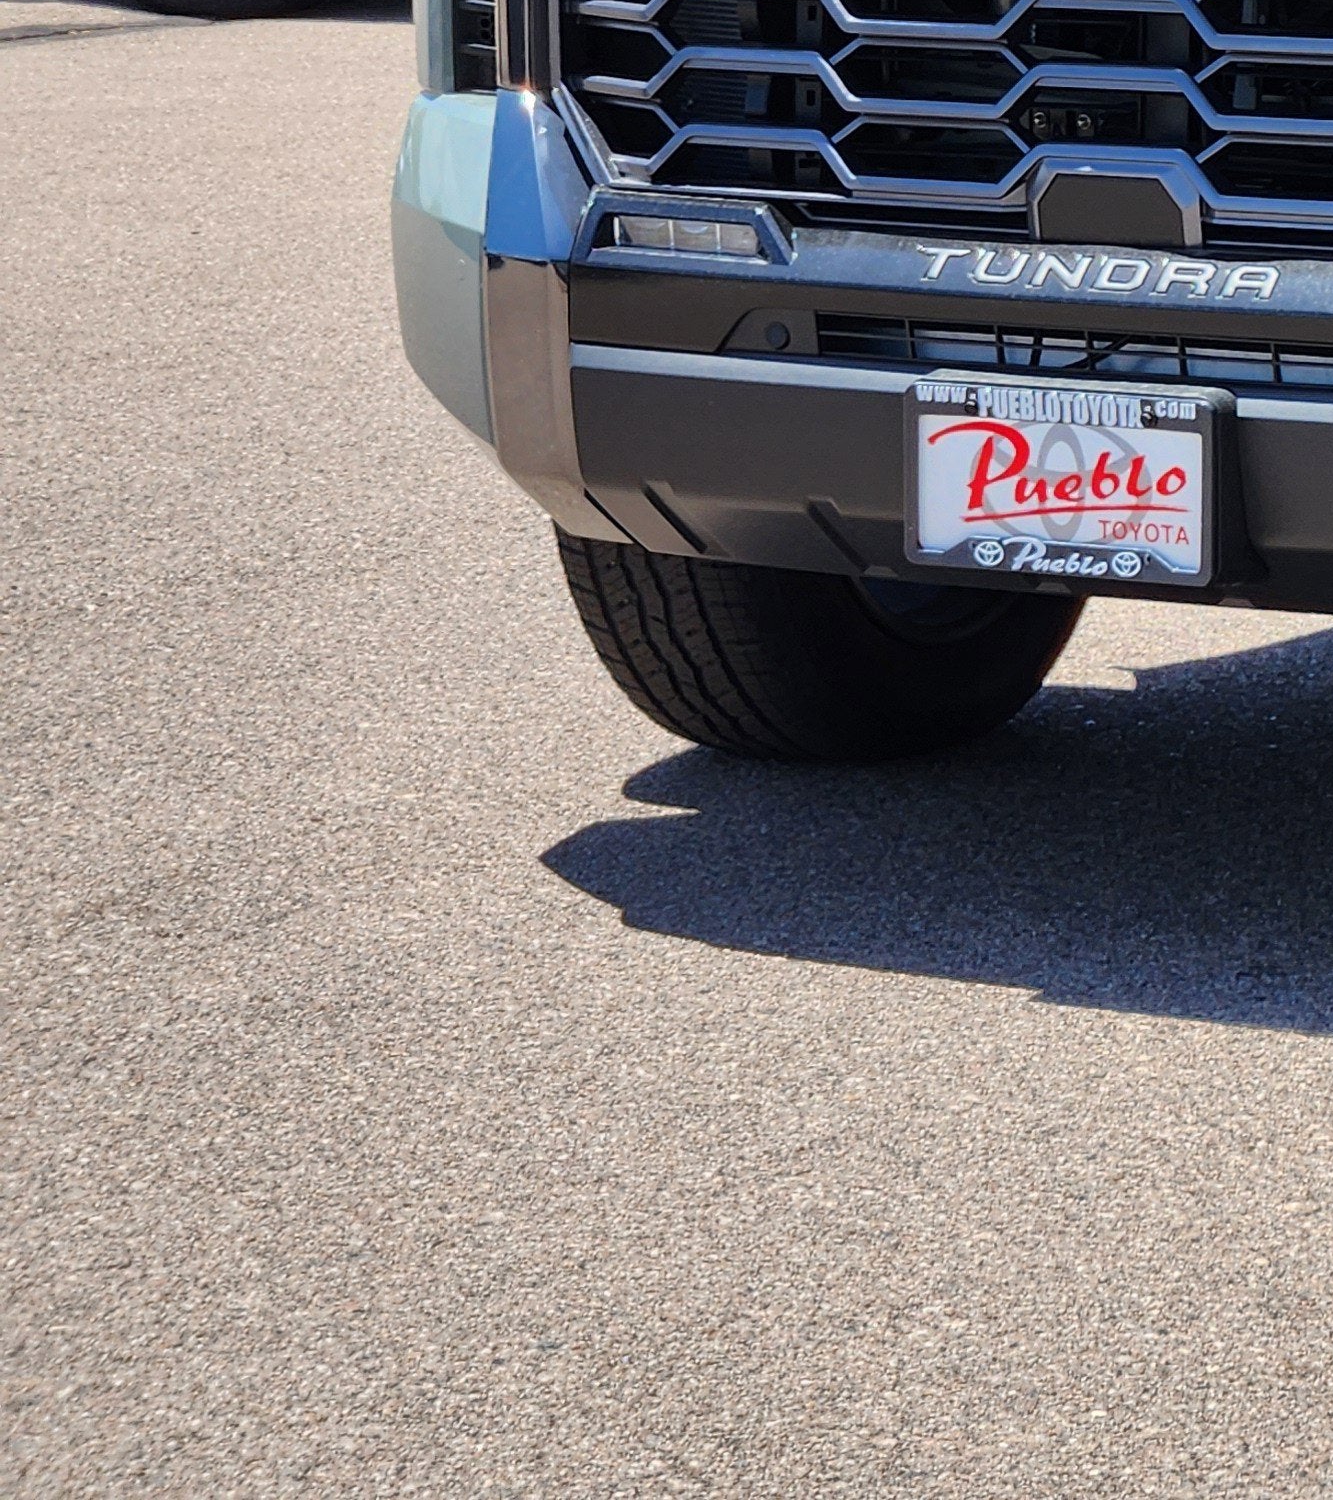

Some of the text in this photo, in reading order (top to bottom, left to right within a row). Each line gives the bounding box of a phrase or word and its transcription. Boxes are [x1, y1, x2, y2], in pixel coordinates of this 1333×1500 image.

[916, 244, 1281, 300] TUNDRA
[928, 421, 1187, 510] Pueblo
[1003, 536, 1108, 576] Pueblo
[1098, 519, 1189, 545] TOYOTA
